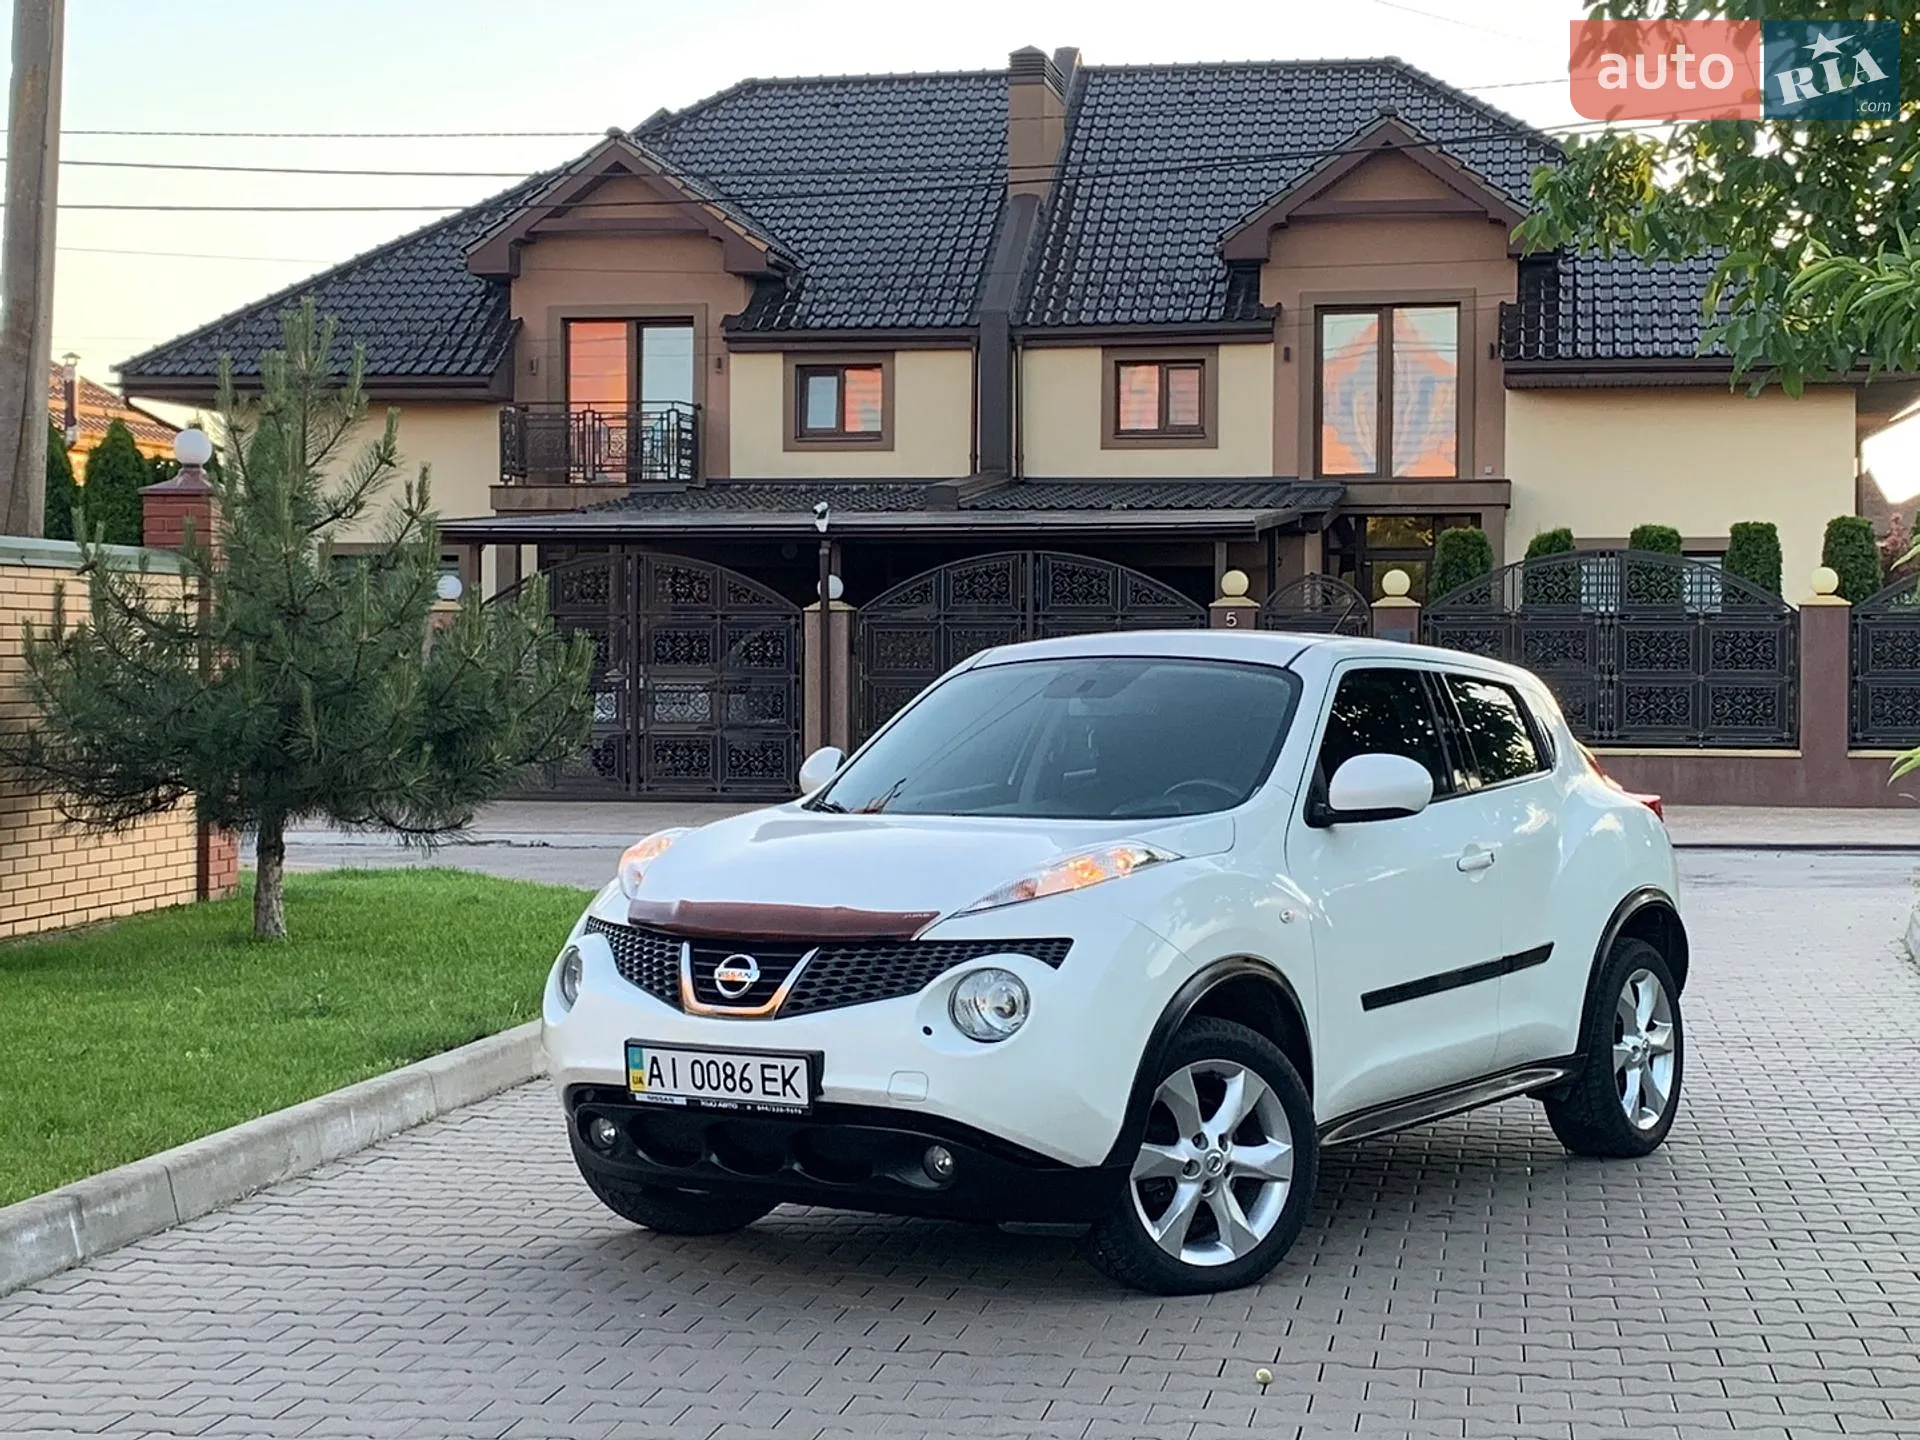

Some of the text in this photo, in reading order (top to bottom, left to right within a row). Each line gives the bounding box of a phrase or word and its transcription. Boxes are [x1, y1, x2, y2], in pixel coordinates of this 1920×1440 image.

[1225, 611, 1237, 627] 5
[718, 970, 752, 980] NISSAN
[632, 1075, 644, 1086] UA
[691, 1059, 753, 1094] 0086
[760, 1063, 801, 1099] EK
